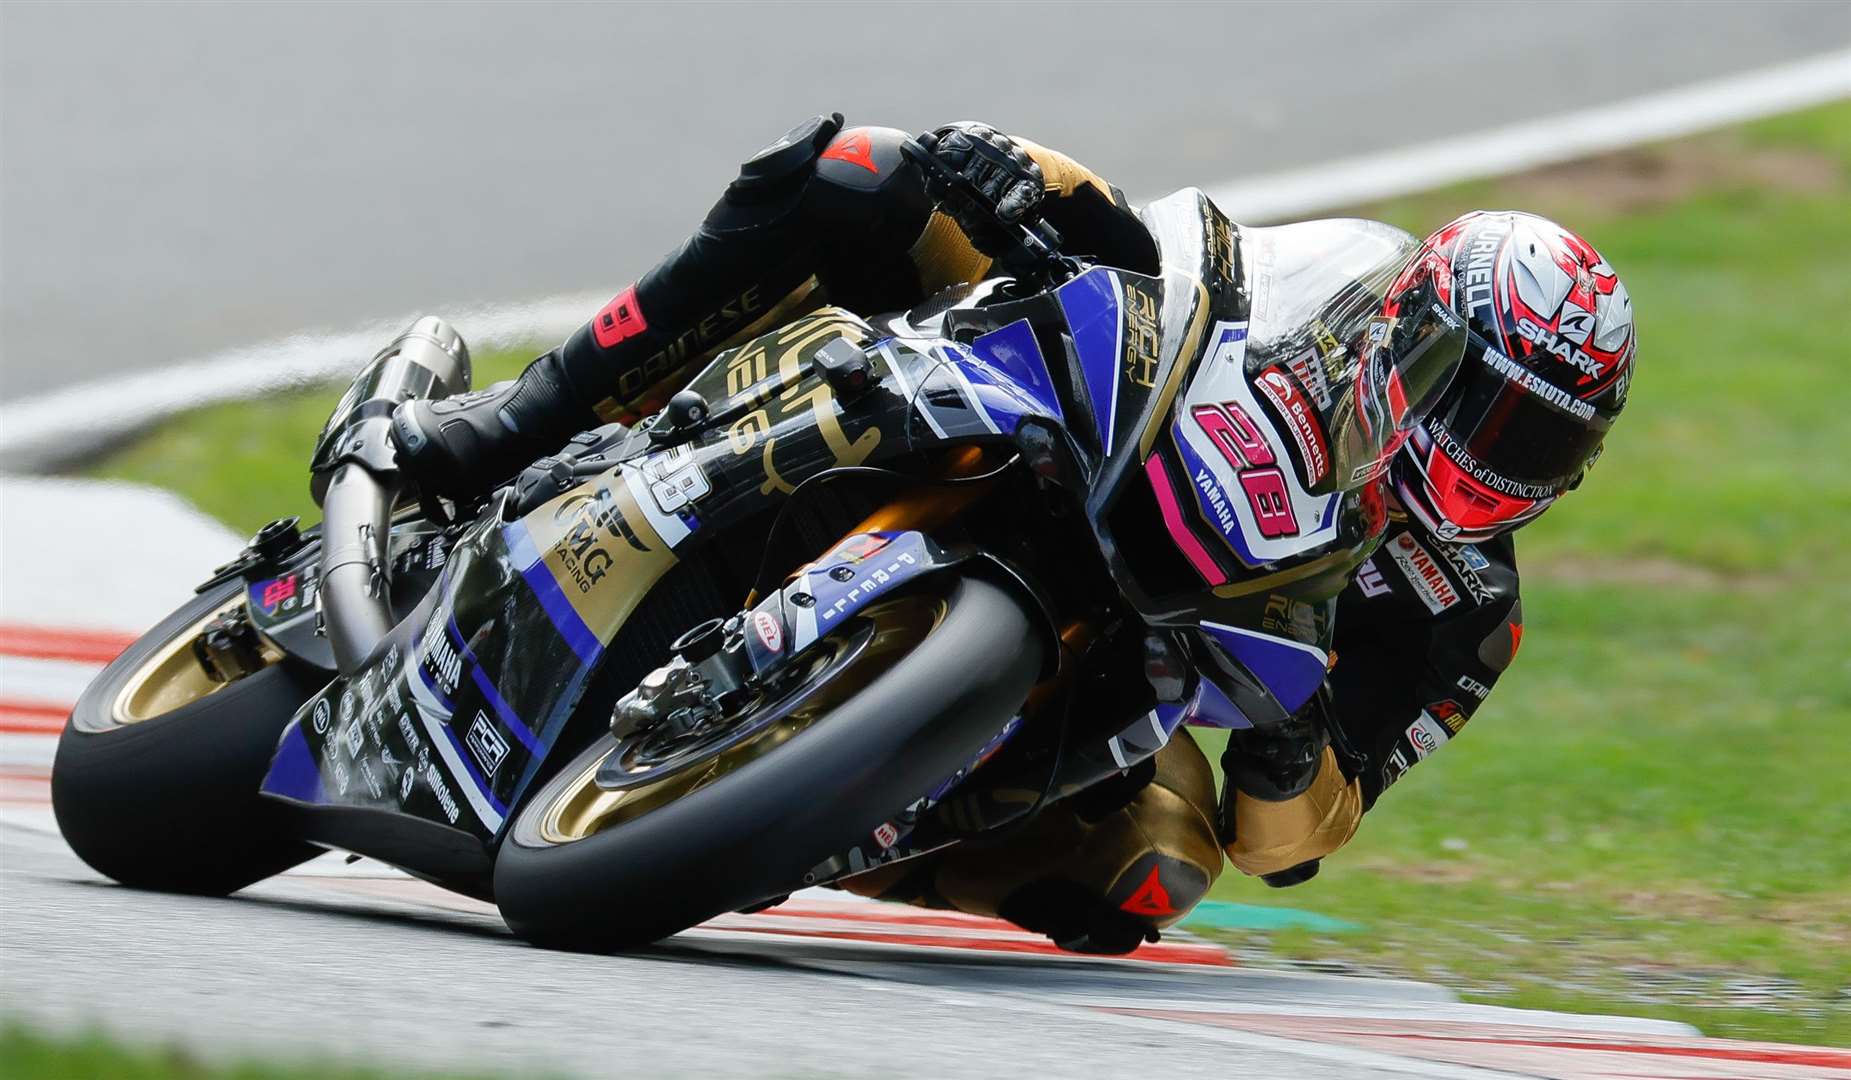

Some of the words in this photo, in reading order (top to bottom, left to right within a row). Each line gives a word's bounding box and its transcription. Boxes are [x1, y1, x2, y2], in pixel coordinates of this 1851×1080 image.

[618, 284, 761, 396] DAINESE
[1126, 284, 1138, 385] ENERGY
[1136, 289, 1158, 389] RICH
[1432, 303, 1461, 330] SHARK
[1516, 318, 1604, 379] SHARK
[1258, 380, 1289, 418] BRITISH
[1482, 346, 1596, 421] WWW.ESKUTA.COM
[1190, 401, 1300, 538] 28
[1291, 401, 1325, 478] Bennetts
[1428, 417, 1477, 473] WATCHES
[1473, 469, 1488, 482] of
[1485, 472, 1553, 498] DISTINCTION
[1196, 469, 1235, 535] YAMAHA
[823, 552, 916, 620] PIRELLI
[1409, 548, 1457, 607] YAMAHA
[1425, 535, 1496, 607] SHARK
[758, 614, 777, 644] HEL
[473, 716, 507, 764] PCR
[877, 827, 894, 847] HE
